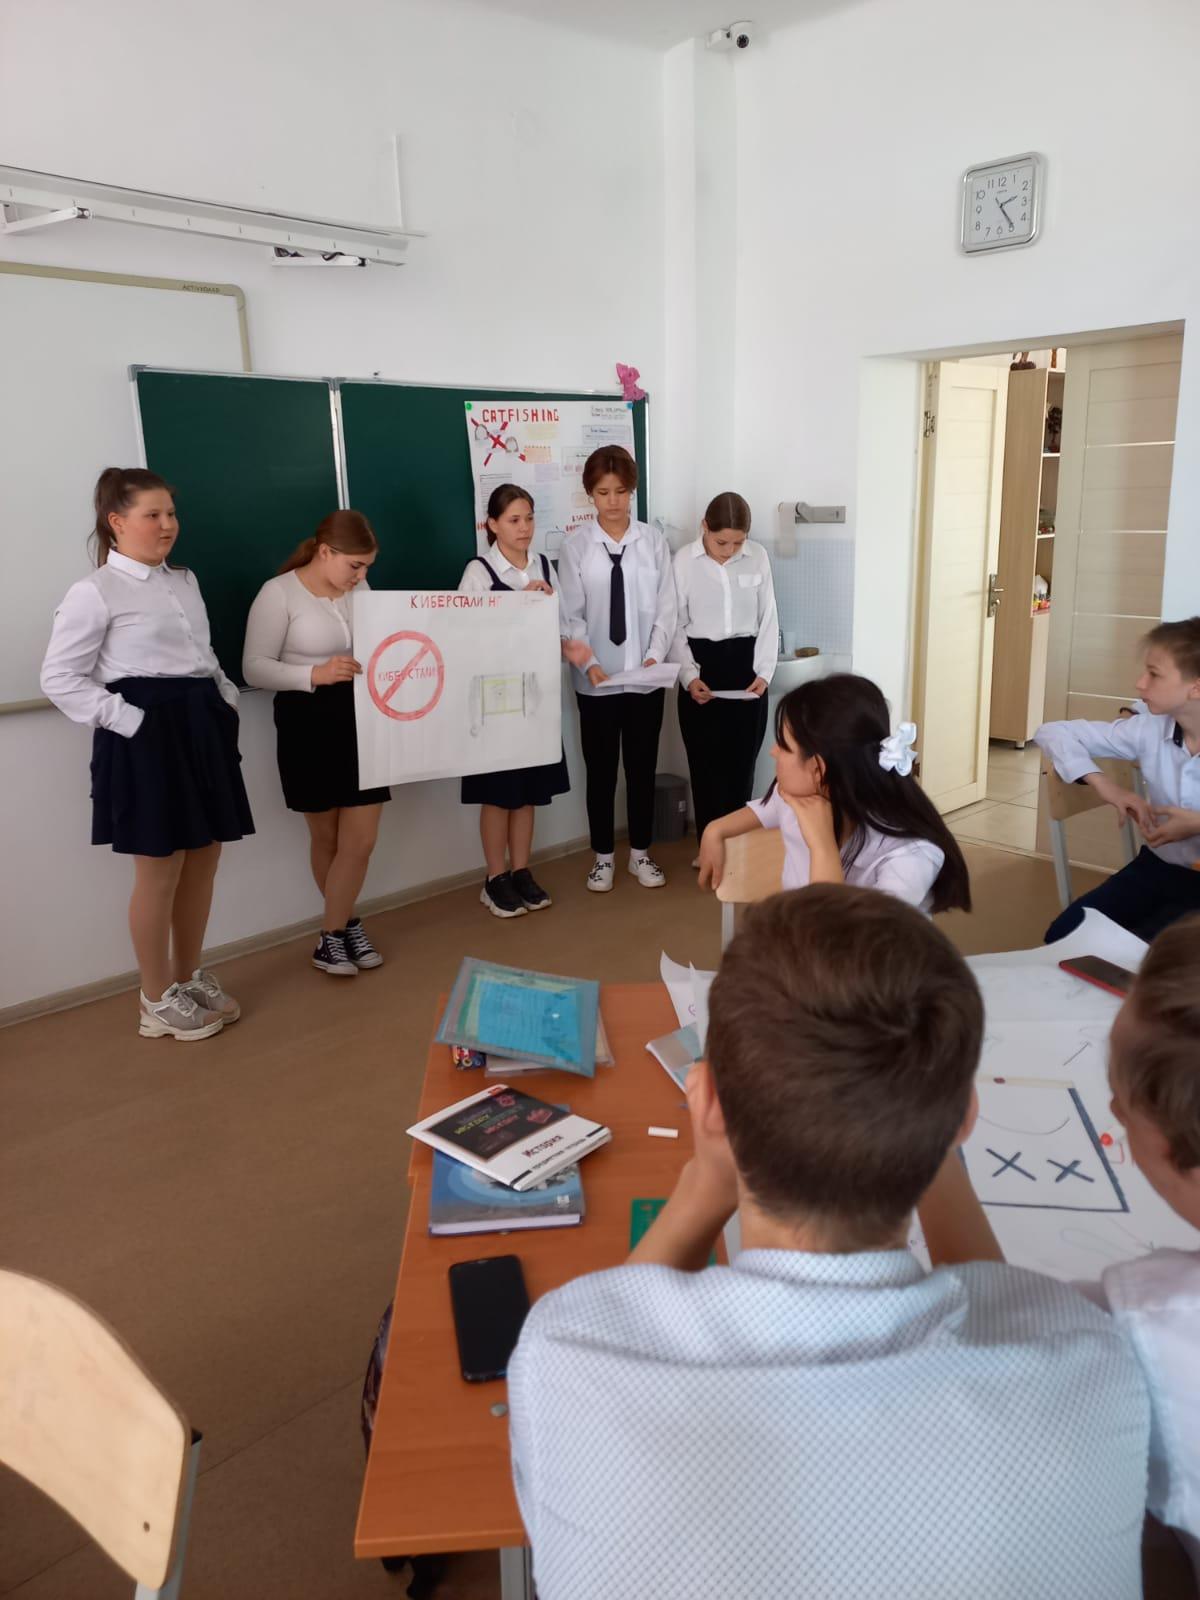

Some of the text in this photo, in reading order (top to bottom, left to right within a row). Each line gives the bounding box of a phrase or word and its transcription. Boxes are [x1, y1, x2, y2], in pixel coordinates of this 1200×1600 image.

[987, 179, 994, 189] 11
[998, 177, 1007, 187] 12
[1022, 180, 1029, 191] 2
[976, 190, 985, 200] 10
[1021, 196, 1027, 206] 3
[1020, 212, 1026, 221] 4
[975, 221, 981, 231] 8
[985, 227, 991, 237] 7
[482, 408, 560, 423] CATFISHING
